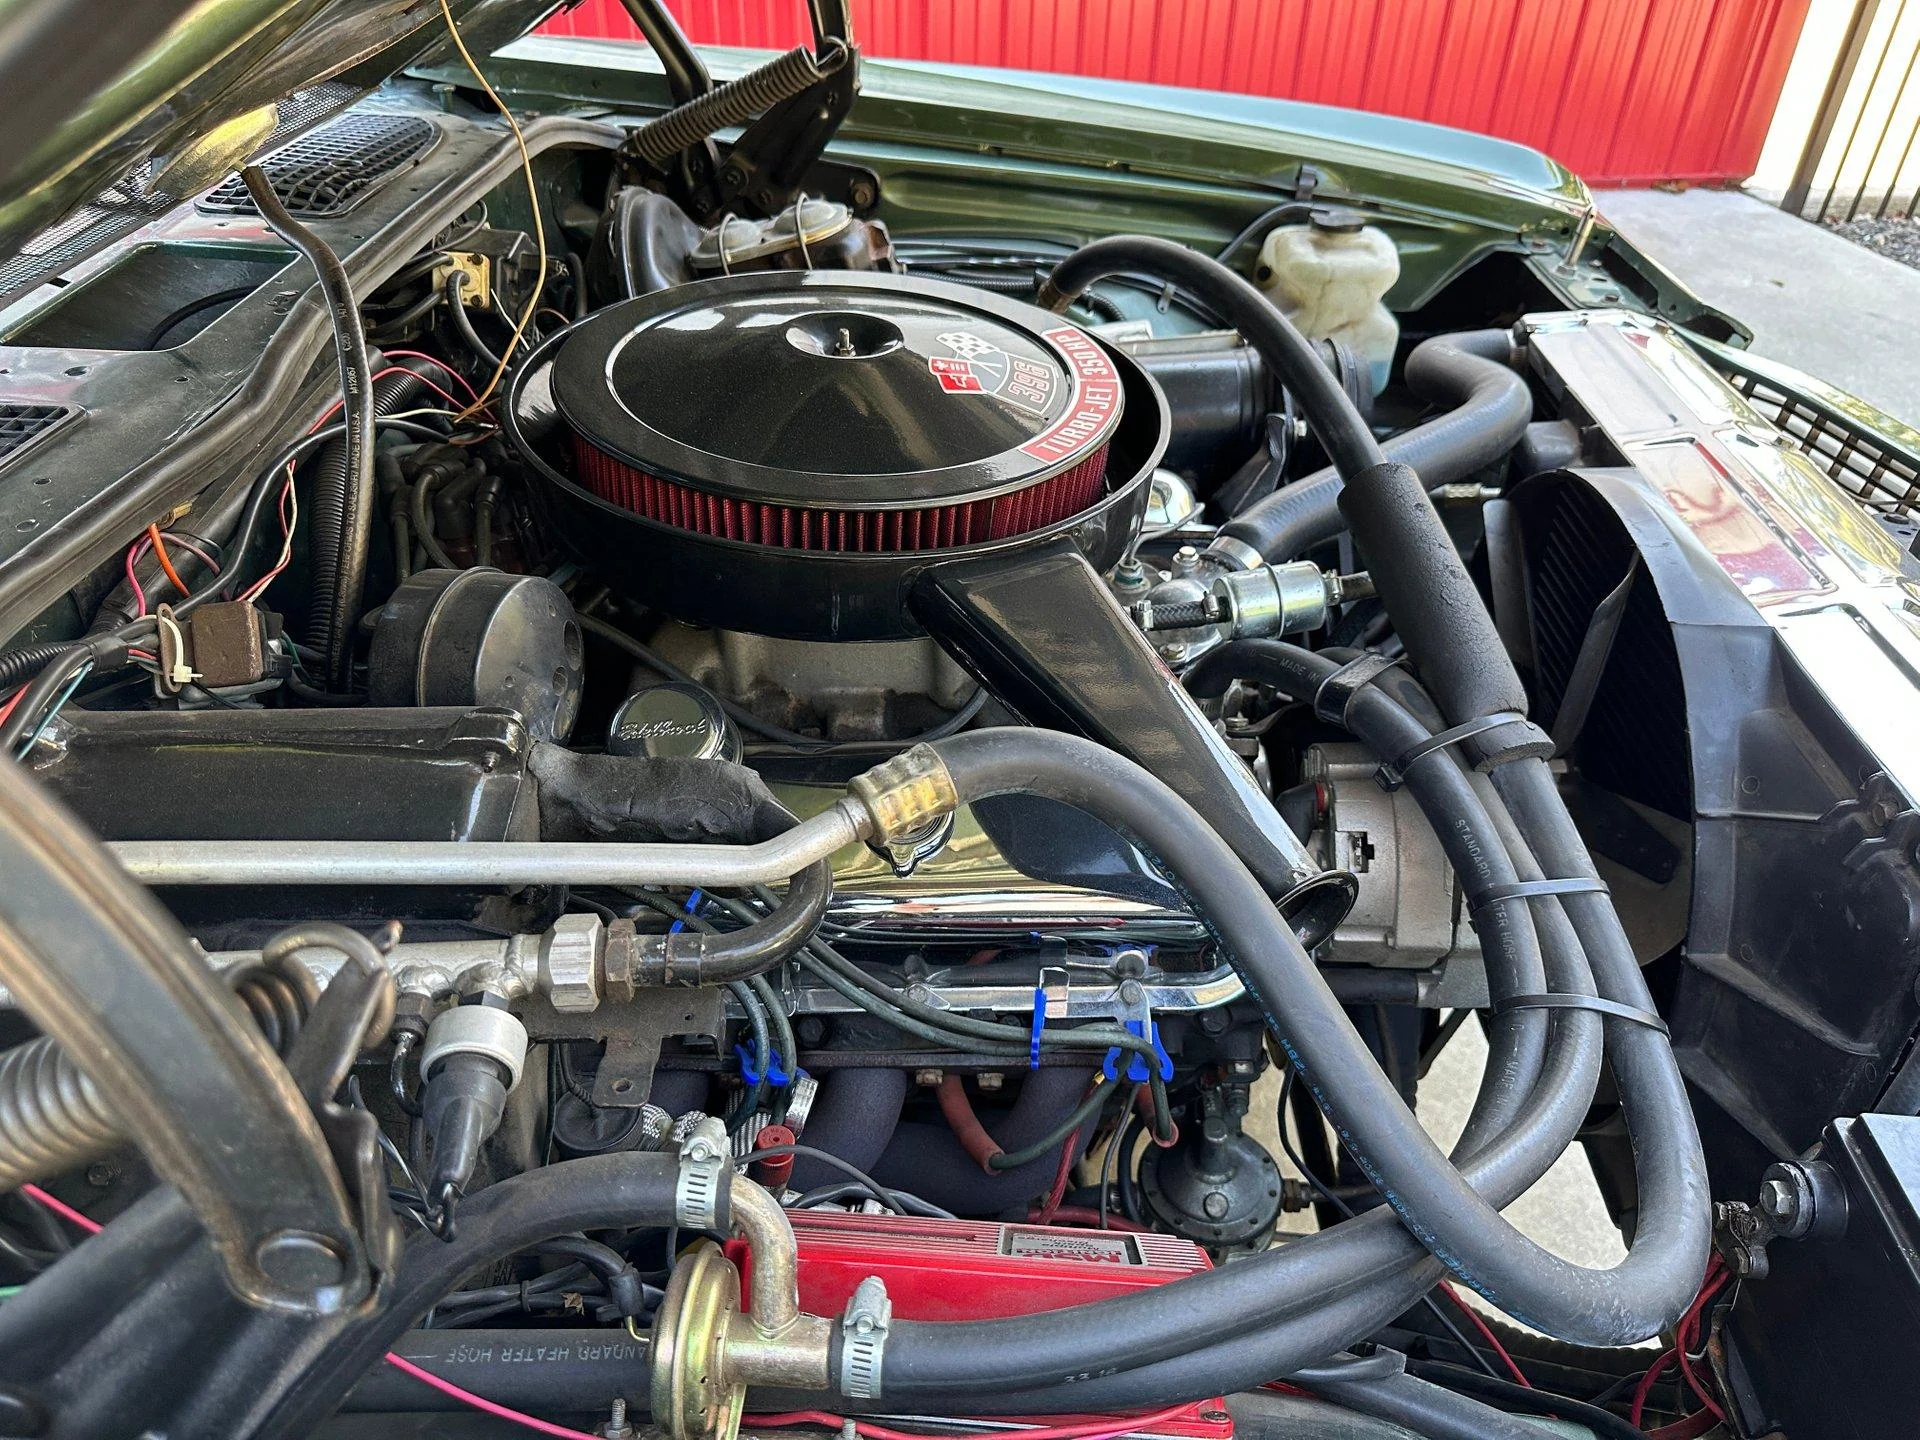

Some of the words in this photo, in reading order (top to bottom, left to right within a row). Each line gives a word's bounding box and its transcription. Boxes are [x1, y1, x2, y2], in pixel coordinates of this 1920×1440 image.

[1056, 334, 1090, 351] HP
[1073, 350, 1109, 376] 350
[1008, 360, 1050, 404] 396
[1038, 384, 1113, 454] TURBO-JET
[351, 434, 360, 443] IN
[351, 444, 360, 468] MADE
[1279, 658, 1307, 676] MADE
[619, 718, 706, 741] Edelbrock
[1455, 819, 1491, 879] STANDARD
[1501, 931, 1517, 963] HOSE
[446, 1344, 492, 1363] HOSE
[501, 1346, 570, 1362] HEATER
